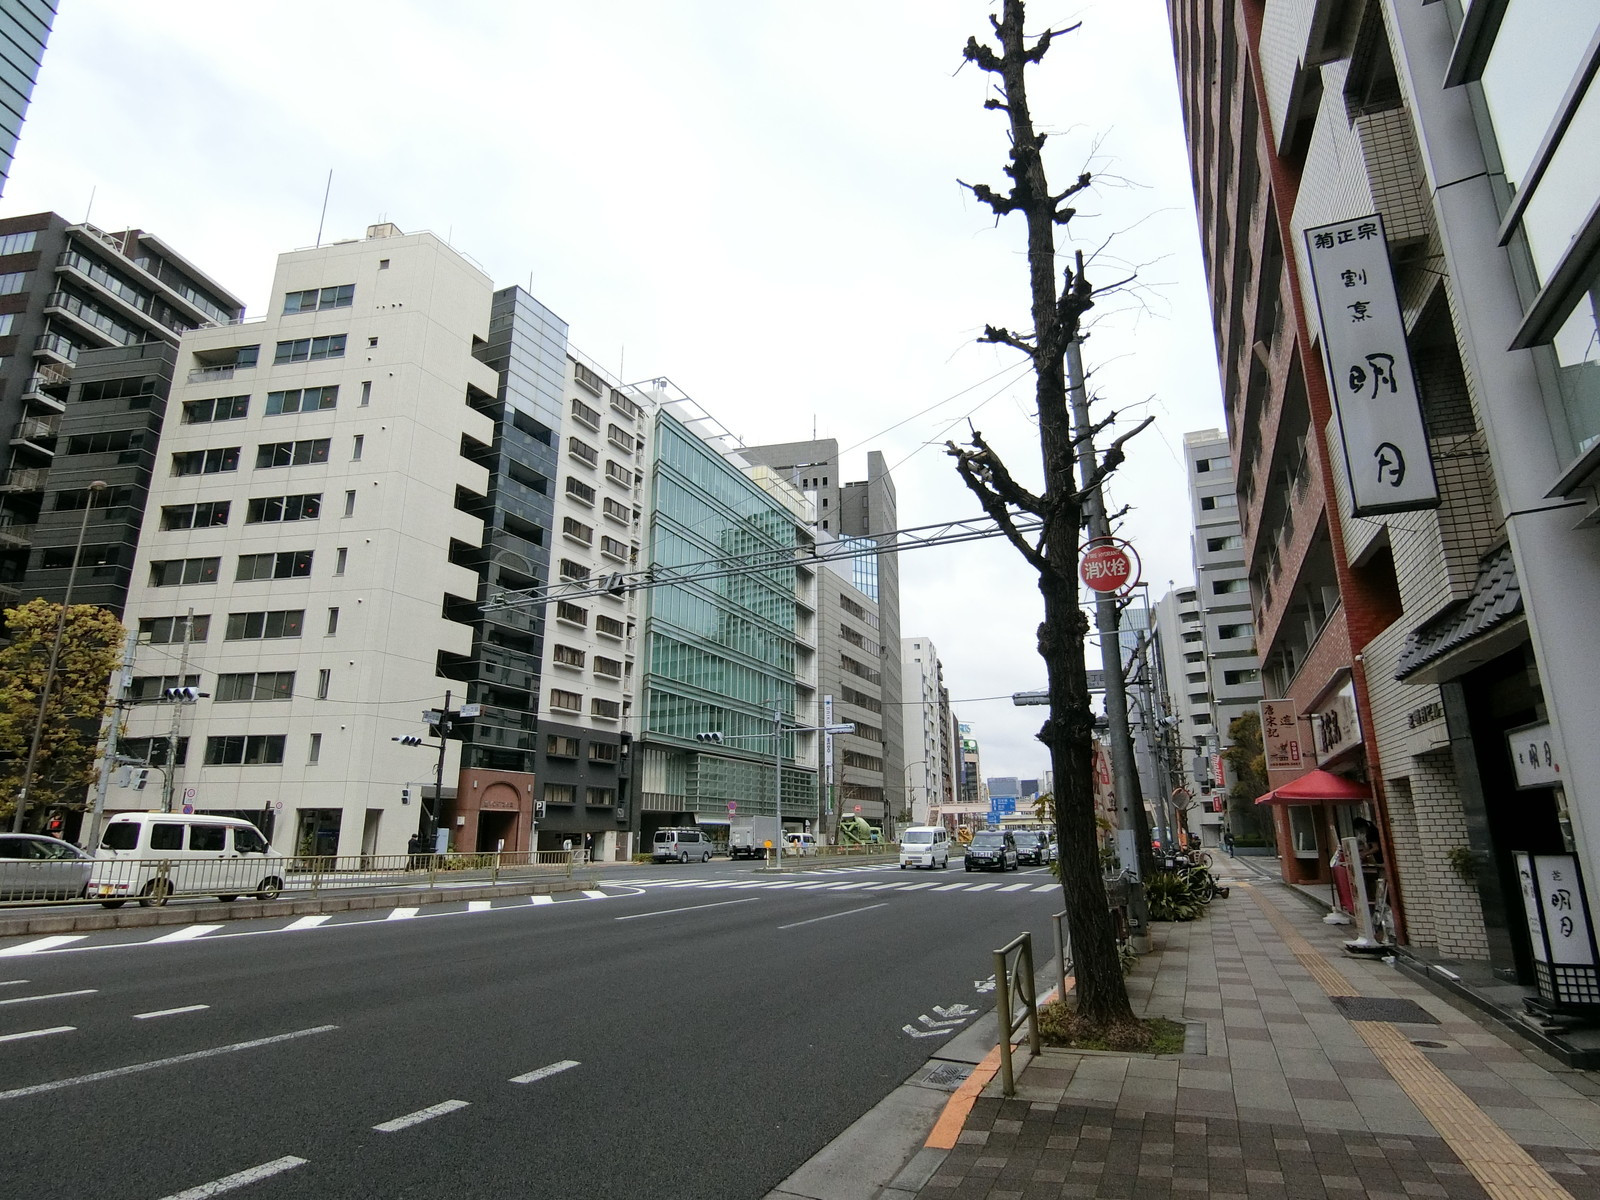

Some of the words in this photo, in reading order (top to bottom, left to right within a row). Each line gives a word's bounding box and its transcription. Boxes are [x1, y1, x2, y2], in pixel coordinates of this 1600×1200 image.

[1314, 222, 1379, 250] 菊正宗
[1340, 268, 1373, 323] 割烹
[1348, 352, 1407, 488] 明月
[1084, 557, 1127, 580] 消火栓
[1529, 741, 1552, 769] 明月
[1551, 889, 1573, 937] 明月
